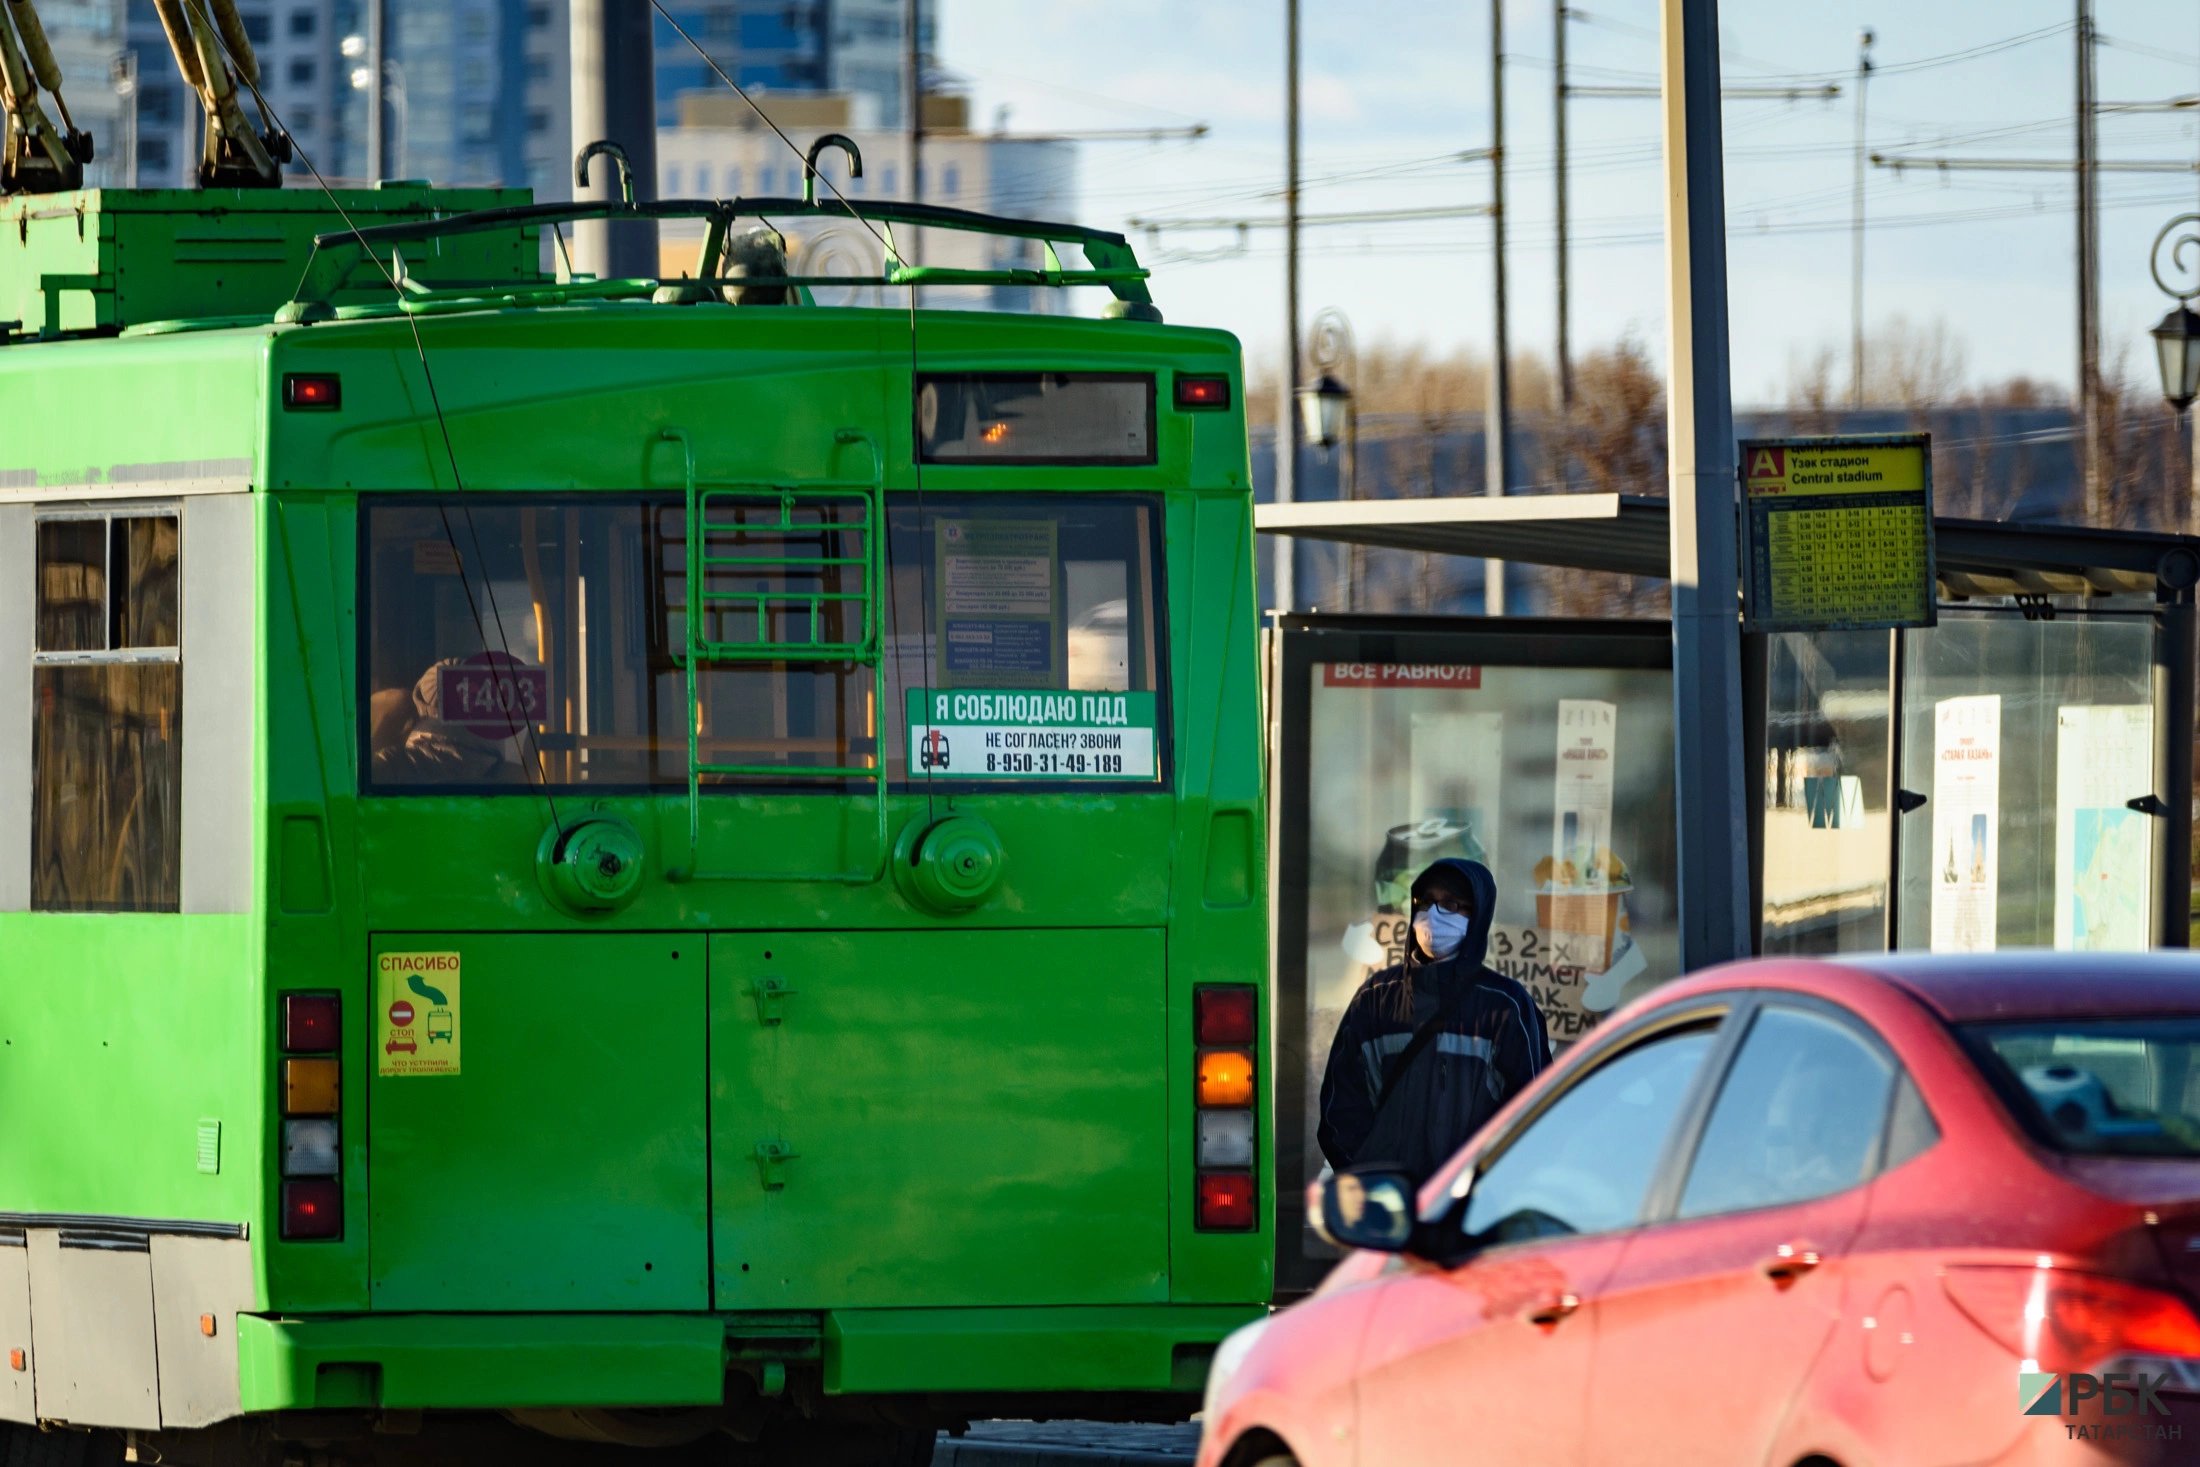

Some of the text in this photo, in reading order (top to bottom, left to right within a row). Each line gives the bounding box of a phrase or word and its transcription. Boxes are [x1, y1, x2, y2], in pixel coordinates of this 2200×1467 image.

[1791, 456, 1869, 469] Үзәк стадион
[1792, 470, 1883, 485] Central stadium
[1382, 664, 1472, 680] РАВНО?!
[456, 676, 536, 713] 1403
[936, 694, 1128, 725] Я СОБЛЮДАЮ ПДД
[986, 732, 1121, 749] НЕ СОГЛАСЕН? ЗВОНИ
[987, 753, 1122, 773] 8-950-31-49-189
[380, 956, 459, 971] СПАСИБО
[390, 1029, 415, 1037] СТОП
[380, 1066, 407, 1074] ДОРОГУ
[409, 1059, 448, 1067] УСТУПИЛИ
